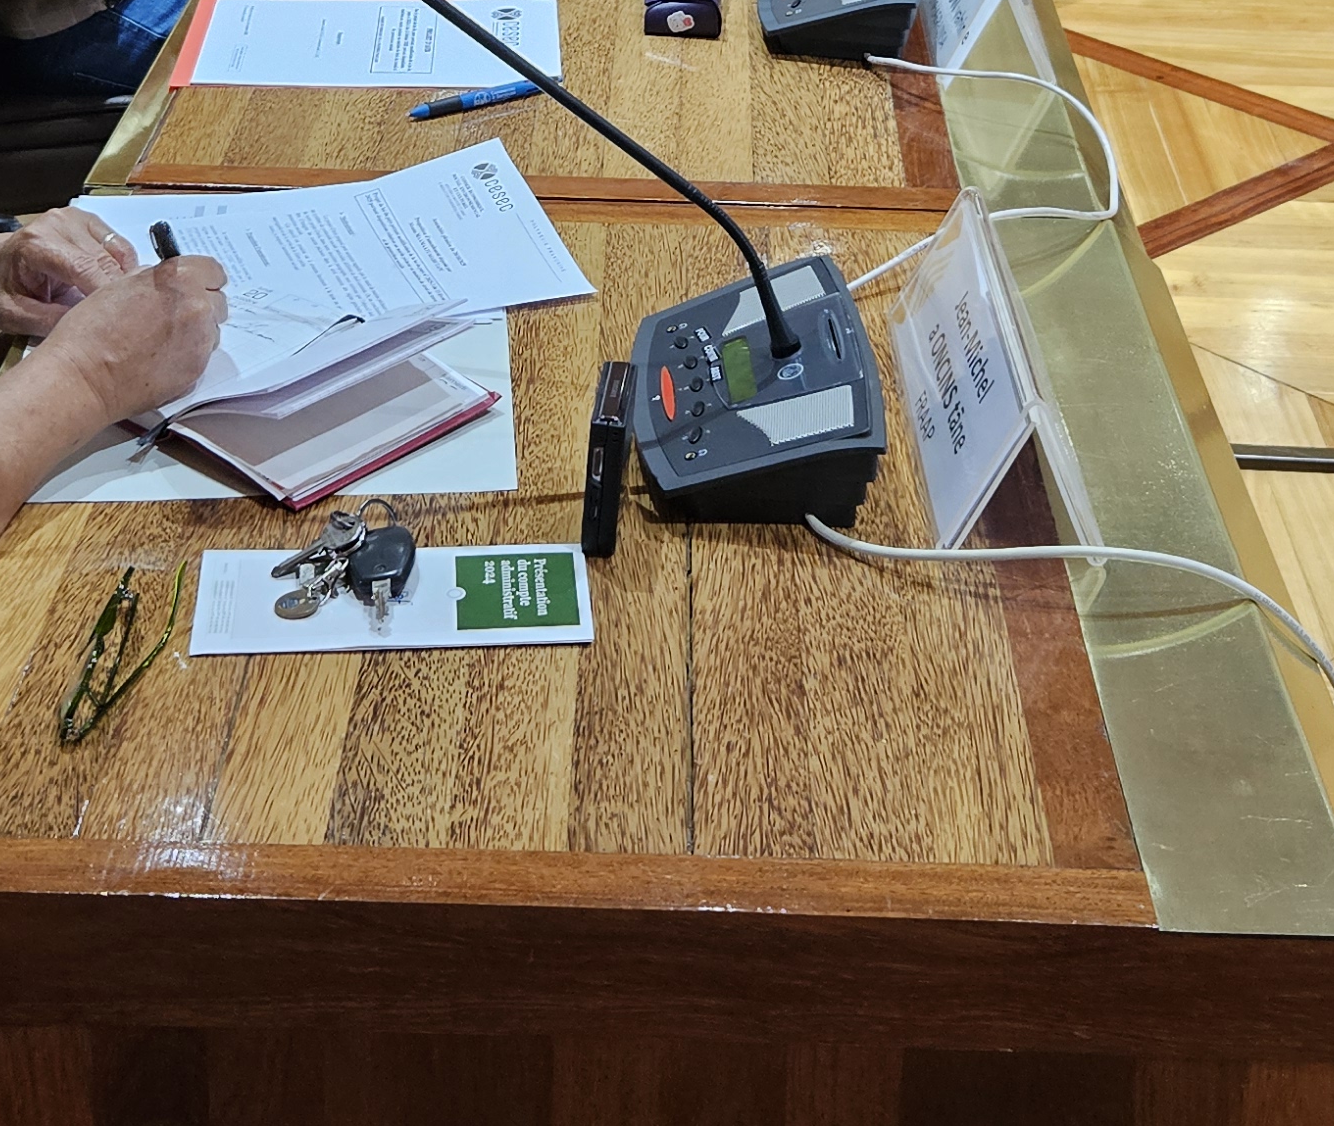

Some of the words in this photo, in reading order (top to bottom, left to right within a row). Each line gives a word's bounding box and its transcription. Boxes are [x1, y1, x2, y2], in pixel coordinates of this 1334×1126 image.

[484, 178, 514, 213] cesec
[928, 323, 940, 343] a
[955, 291, 995, 404] Jean-Michel
[931, 332, 958, 410] ONCINS
[915, 390, 935, 442] FRAAP
[482, 560, 496, 584] 2024
[517, 559, 531, 572] du
[533, 558, 551, 616] Présentation
[501, 560, 518, 620] administratif
[516, 572, 532, 606] compte
